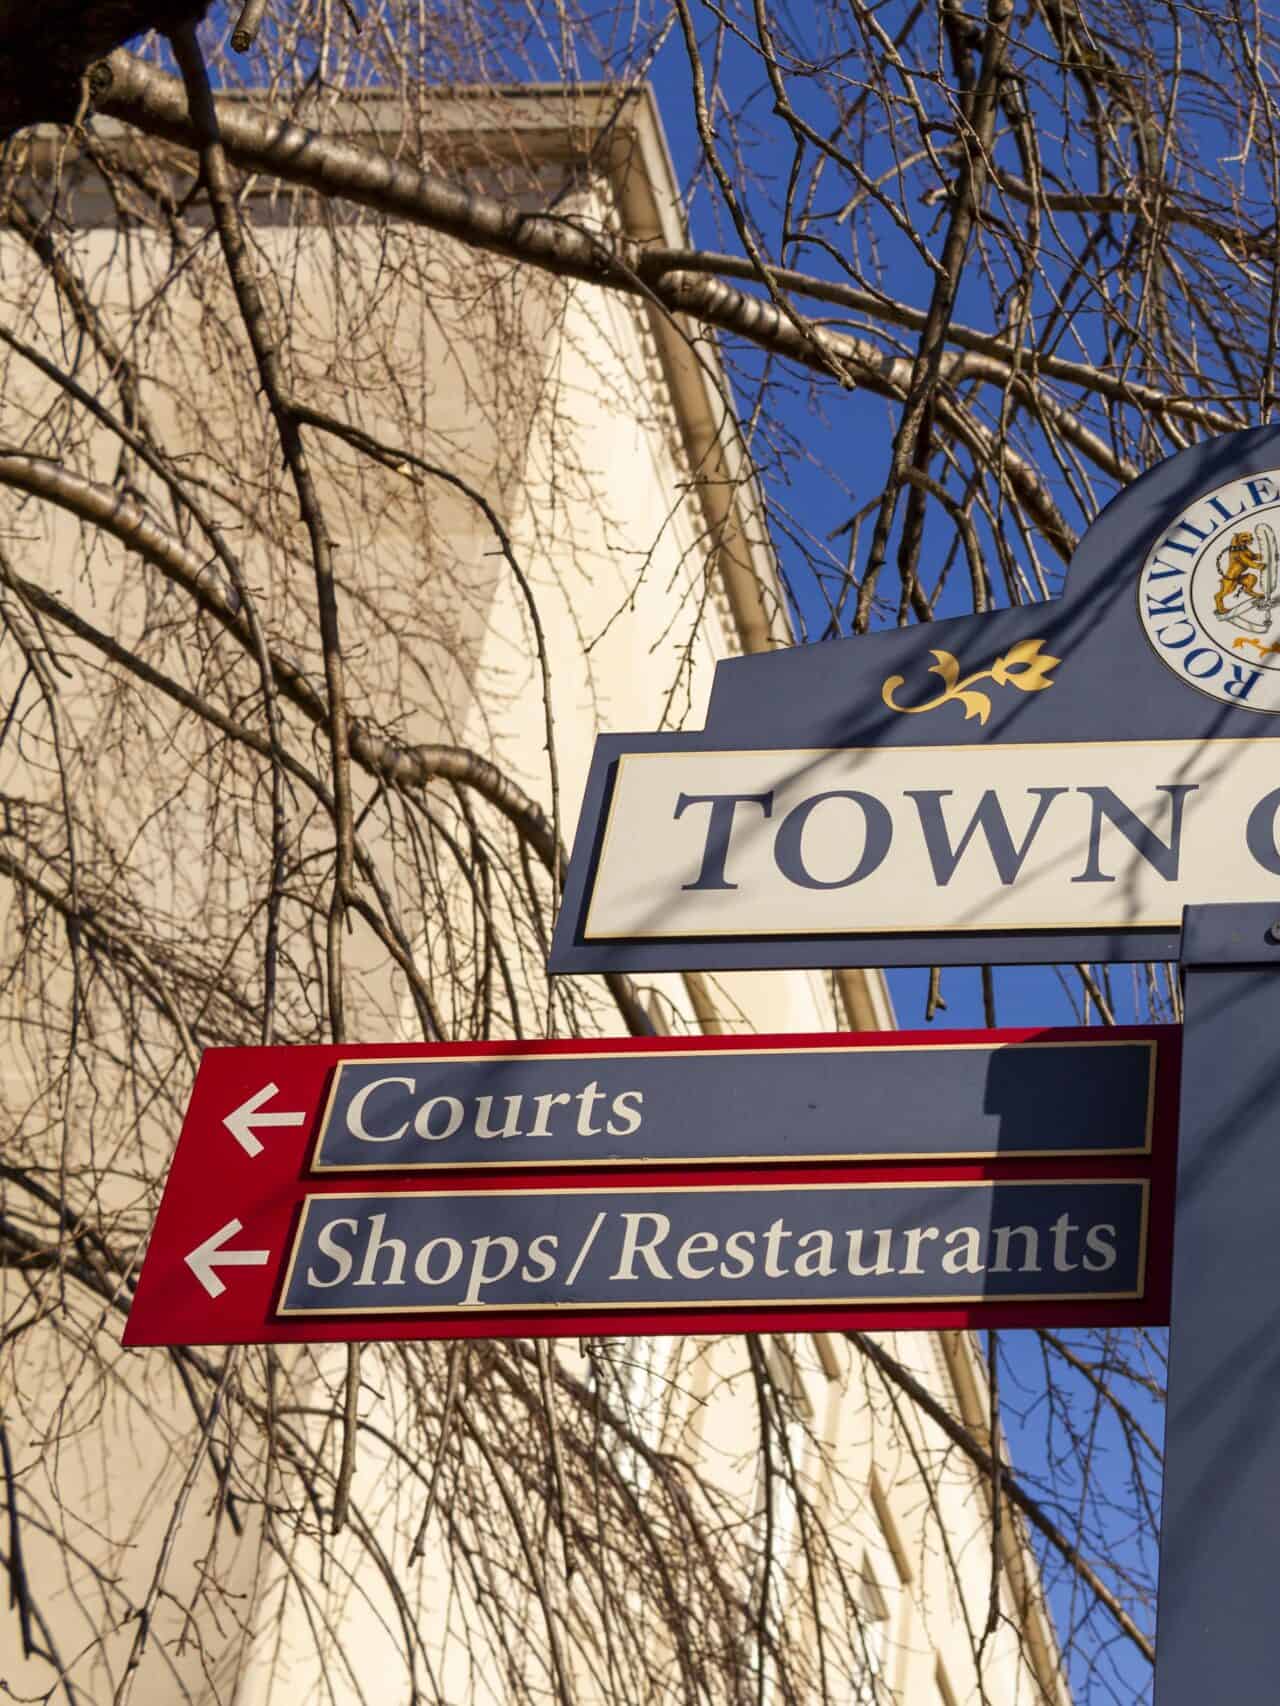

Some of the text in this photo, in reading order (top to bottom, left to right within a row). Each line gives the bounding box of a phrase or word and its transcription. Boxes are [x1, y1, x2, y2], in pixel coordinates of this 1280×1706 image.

[673, 784, 1199, 891] TOWN
[344, 1076, 645, 1143] Courts
[306, 1211, 1118, 1306] Shops/Restaurants
